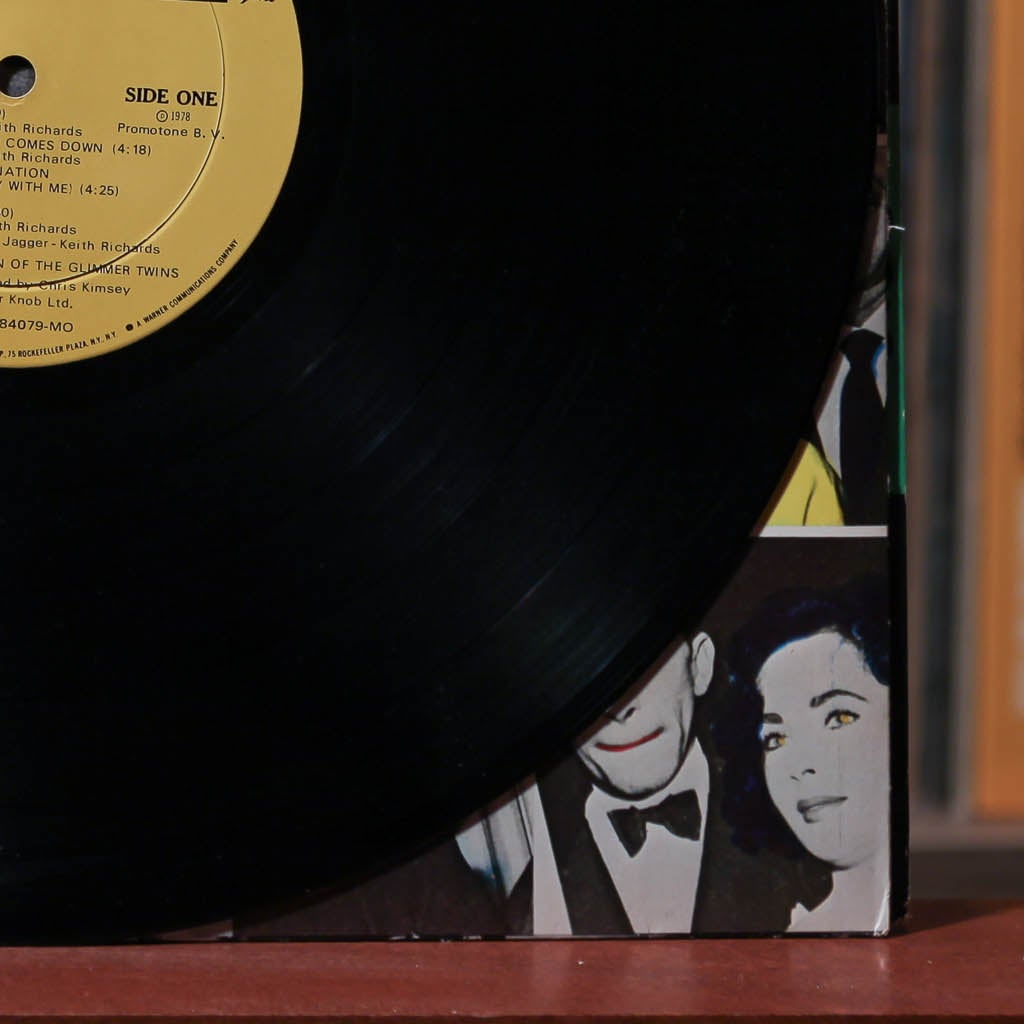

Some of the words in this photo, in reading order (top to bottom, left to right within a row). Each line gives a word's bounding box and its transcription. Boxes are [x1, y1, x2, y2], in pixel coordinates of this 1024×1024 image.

[125, 87, 169, 104] SIDE
[177, 90, 218, 106] ONE
[171, 111, 191, 122] 1978
[23, 123, 82, 136] Richards
[118, 123, 188, 137] Promotone
[6, 138, 54, 151] COMES
[60, 141, 103, 153] DOWN
[112, 144, 151, 156] (4:18)
[21, 152, 81, 165] Richards
[9, 181, 43, 193] WITH
[49, 183, 73, 194] ME)
[80, 184, 119, 196] (4:25)
[17, 222, 77, 235] Richards
[101, 241, 161, 255] Richards
[10, 258, 29, 270] OF
[35, 260, 62, 272] THE
[68, 262, 130, 276] GLIMMER
[136, 266, 180, 279] TWINS
[17, 279, 33, 291] by
[39, 280, 76, 291] Chris
[82, 282, 131, 296] Kimsey
[143, 305, 169, 324] WARNER
[169, 265, 218, 308] COMMUNICATIONS
[215, 239, 239, 267] COMPANY
[9, 294, 41, 306] Knob
[48, 298, 73, 309] Ltd.
[18, 345, 64, 358] ROCKEFELLER
